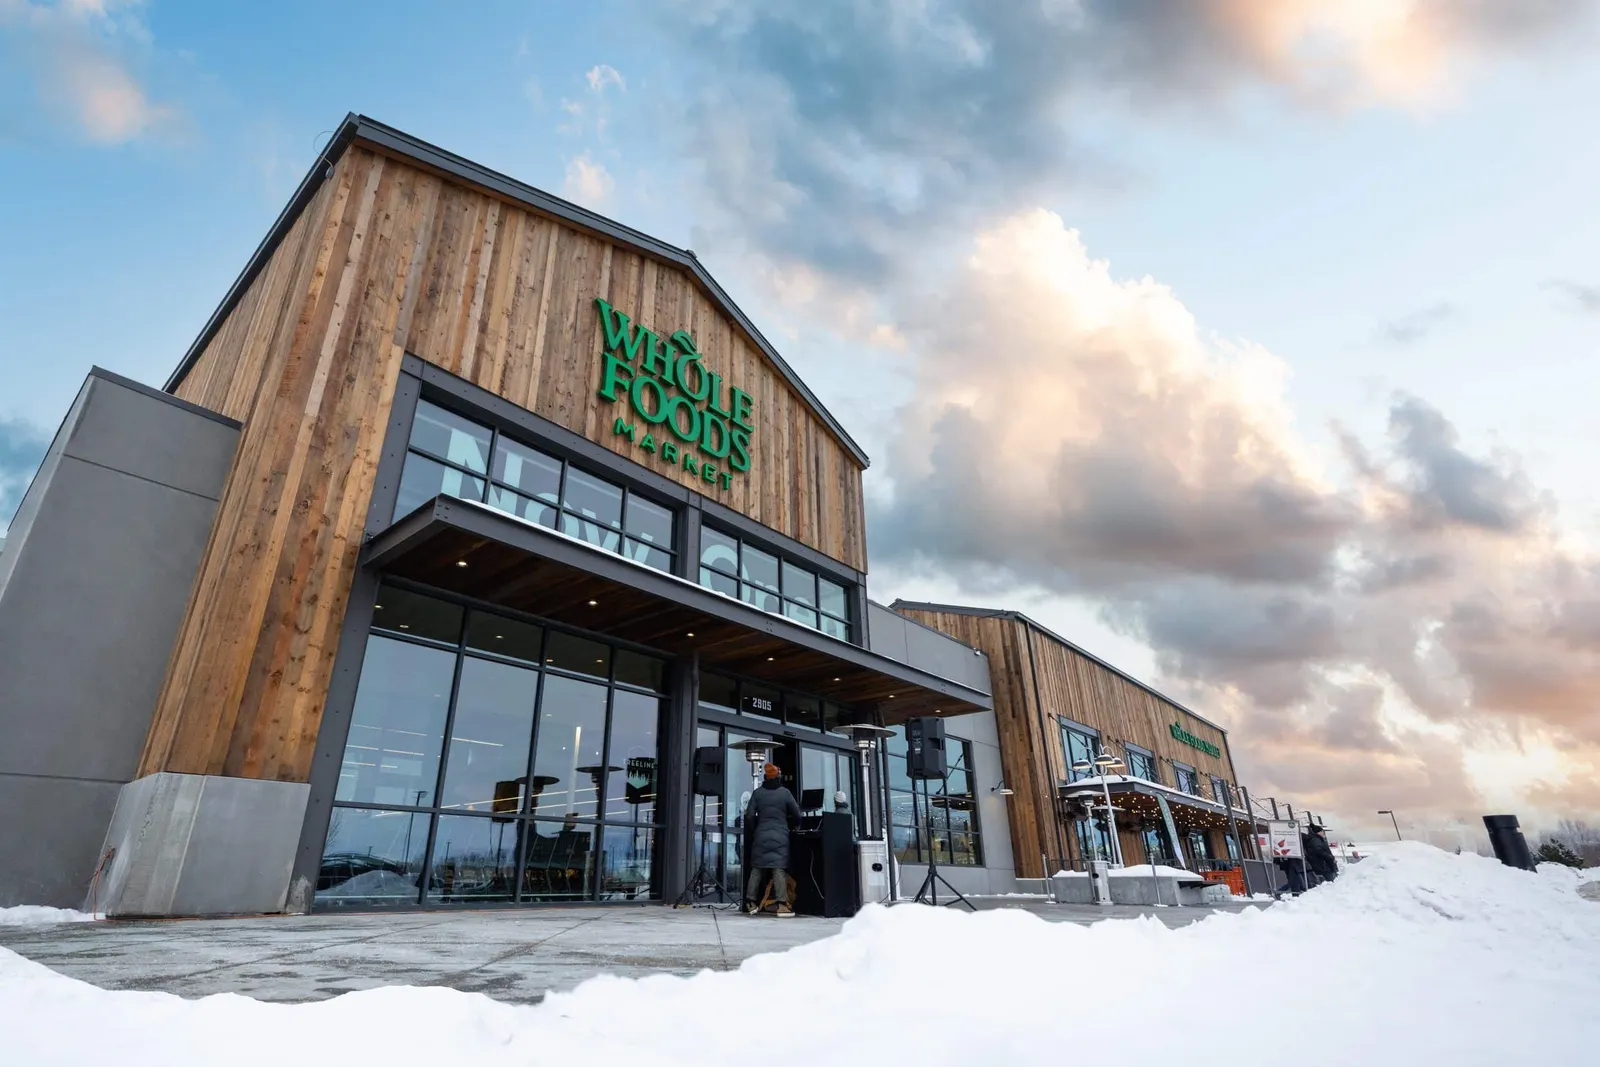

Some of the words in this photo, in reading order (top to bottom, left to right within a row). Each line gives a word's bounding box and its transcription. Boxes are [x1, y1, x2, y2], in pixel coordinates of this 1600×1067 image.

[595, 297, 754, 433] WHOLE
[598, 351, 751, 473] FOODS
[613, 417, 733, 490] MARKET
[752, 697, 772, 711] 2905
